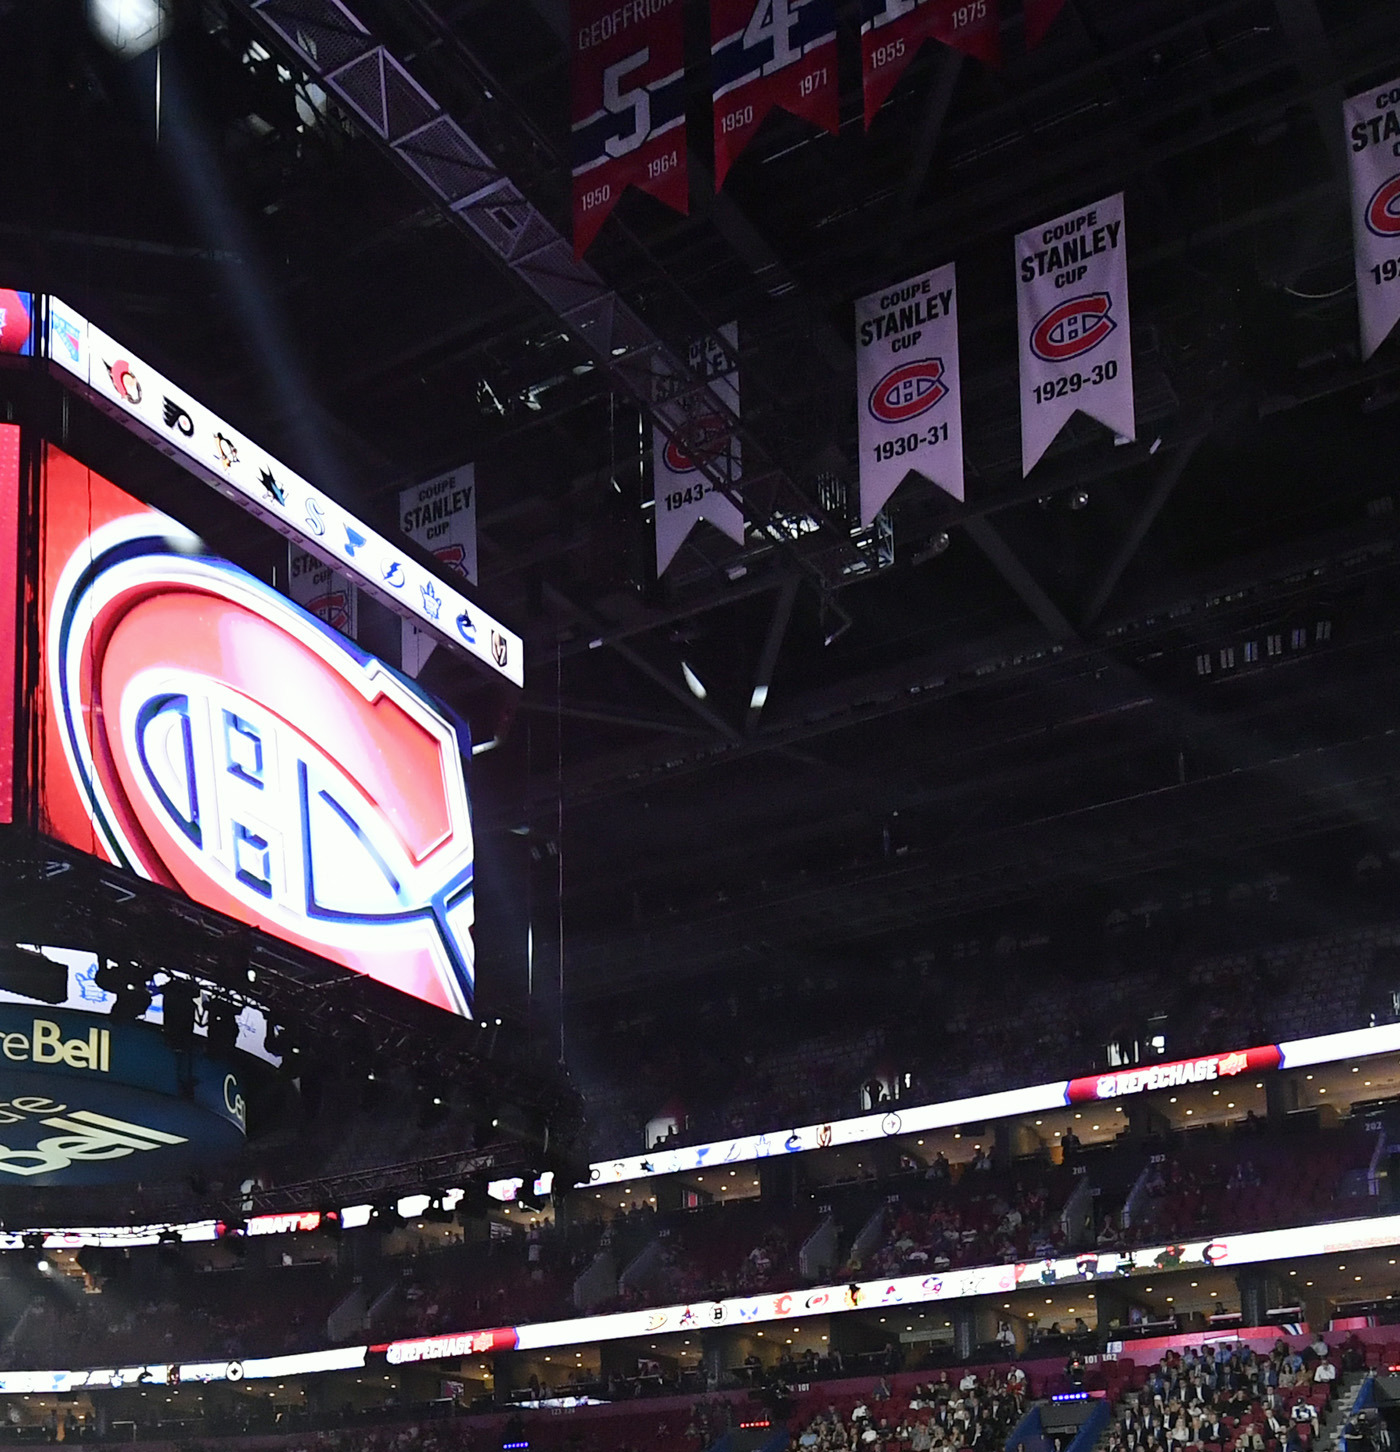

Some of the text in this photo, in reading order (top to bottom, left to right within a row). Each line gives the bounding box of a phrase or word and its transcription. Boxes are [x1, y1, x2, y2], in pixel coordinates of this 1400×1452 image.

[951, 3, 987, 31] 1975
[870, 38, 906, 70] 1955
[799, 67, 828, 98] 1971
[603, 47, 651, 158] 5
[721, 105, 754, 134] 1950
[647, 150, 678, 179] 1964
[581, 185, 611, 212] 1950
[1042, 212, 1097, 245] COUPE
[1020, 220, 1121, 283] STANLEY
[1054, 265, 1088, 290] CUP
[880, 280, 931, 309] COUPE
[860, 289, 953, 345] STANLEY
[891, 331, 922, 353] CUP
[1033, 361, 1118, 404] 1929-30
[873, 423, 949, 462] 1930-31
[419, 477, 456, 502] COUPE
[404, 487, 473, 533] STANLEY
[427, 521, 450, 540] CUP
[1365, 1122, 1382, 1132] 202
[248, 1214, 299, 1236] DRAFT
[1084, 1352, 1117, 1365] 101 102
